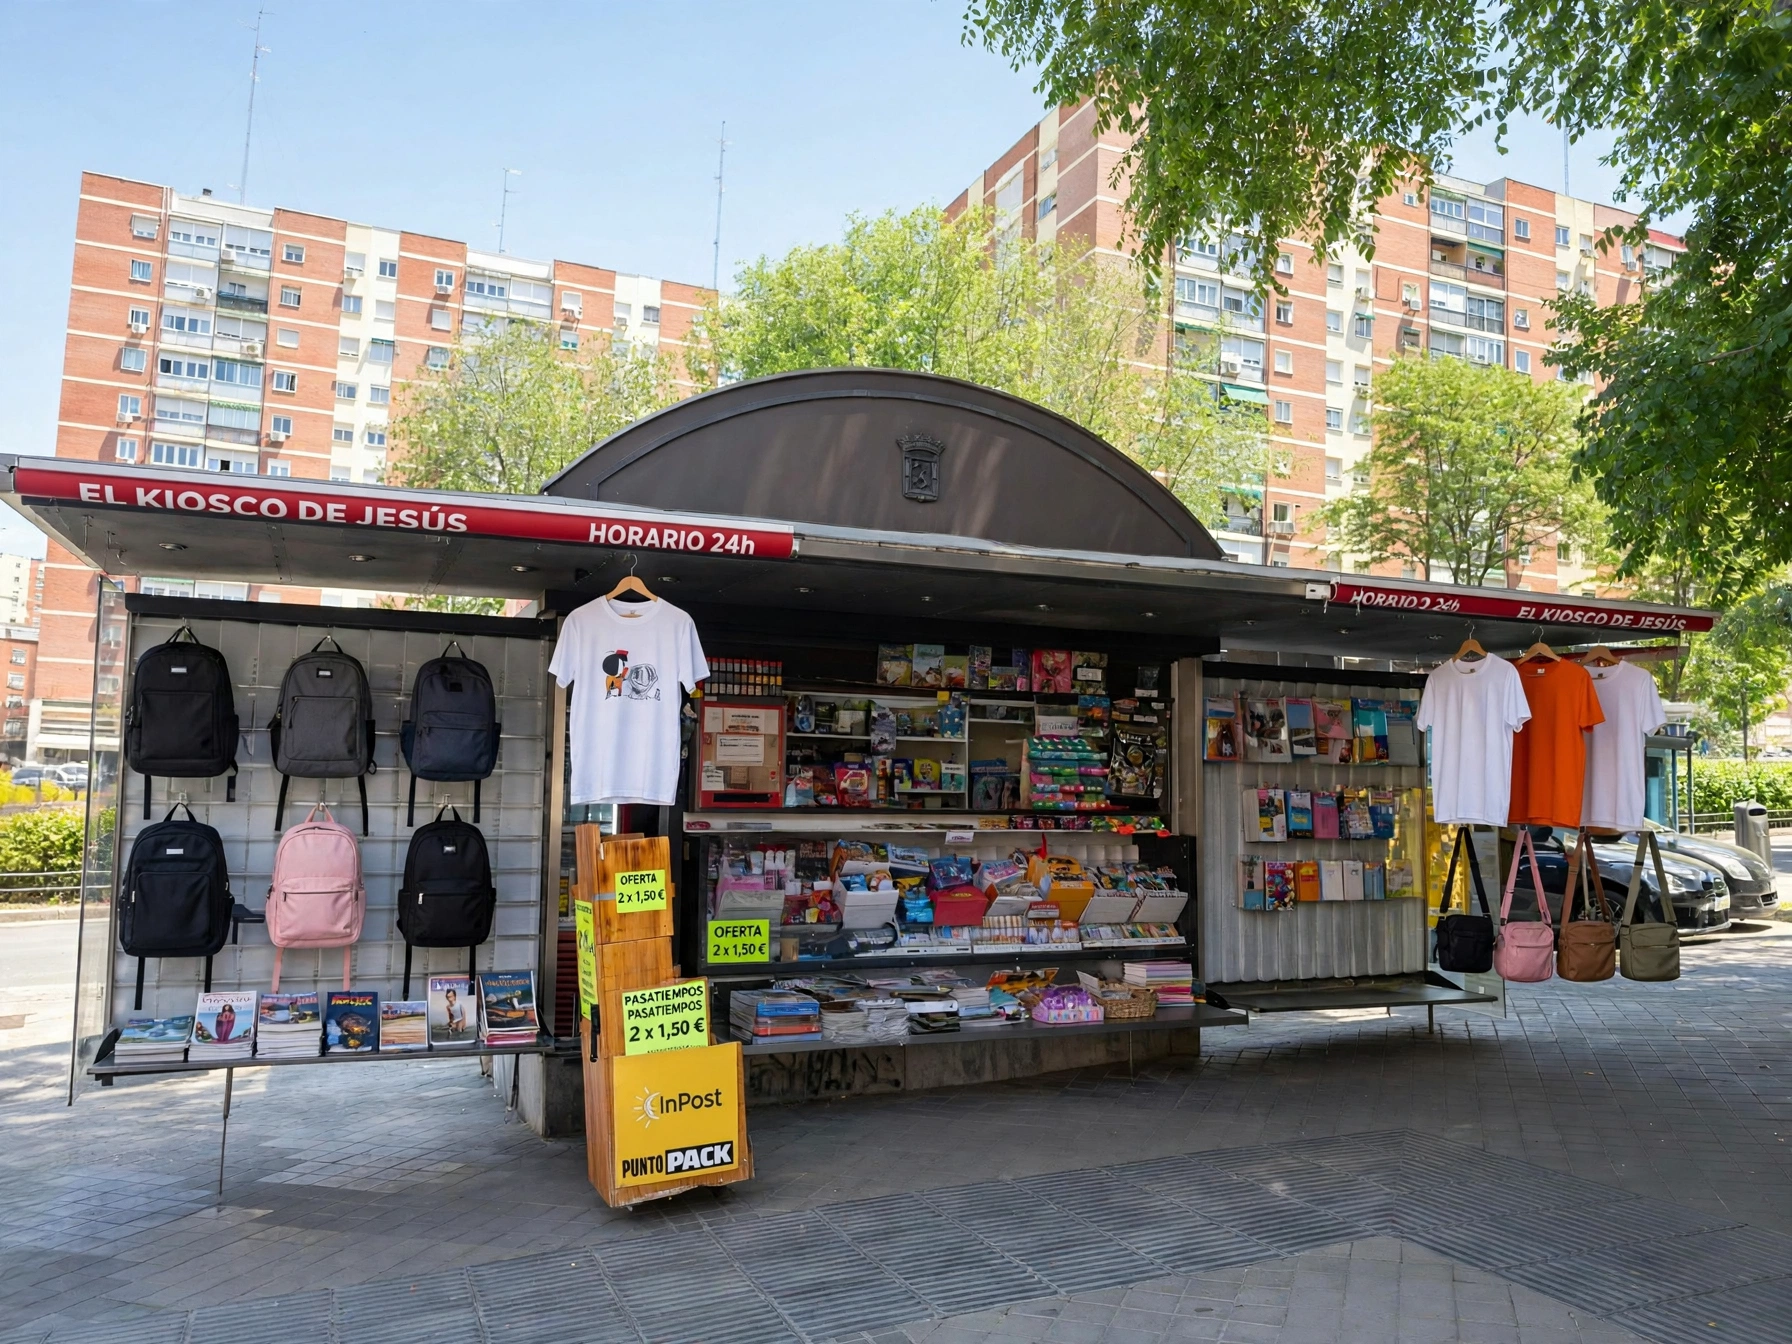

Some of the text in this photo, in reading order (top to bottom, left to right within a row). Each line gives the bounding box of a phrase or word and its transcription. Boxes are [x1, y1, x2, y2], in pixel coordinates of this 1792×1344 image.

[79, 483, 468, 532] EL KIOSCO DE JESÚS
[588, 523, 755, 555] HORARIO 24h
[1516, 606, 1687, 631] EL KIOSCO DE JESÚS
[620, 873, 657, 885] OFERTA
[618, 889, 665, 904] 2 x 1,50 €
[714, 925, 762, 938] OFERTA
[713, 943, 766, 958] 2 x 1,50 €
[624, 985, 704, 1006] PASATIEMPOS
[628, 1000, 703, 1020] PASATIEMPOS
[629, 1017, 705, 1042] 2 x 1,50 €
[660, 1088, 722, 1114] InPost
[622, 1143, 732, 1179] PUNTO PACK
